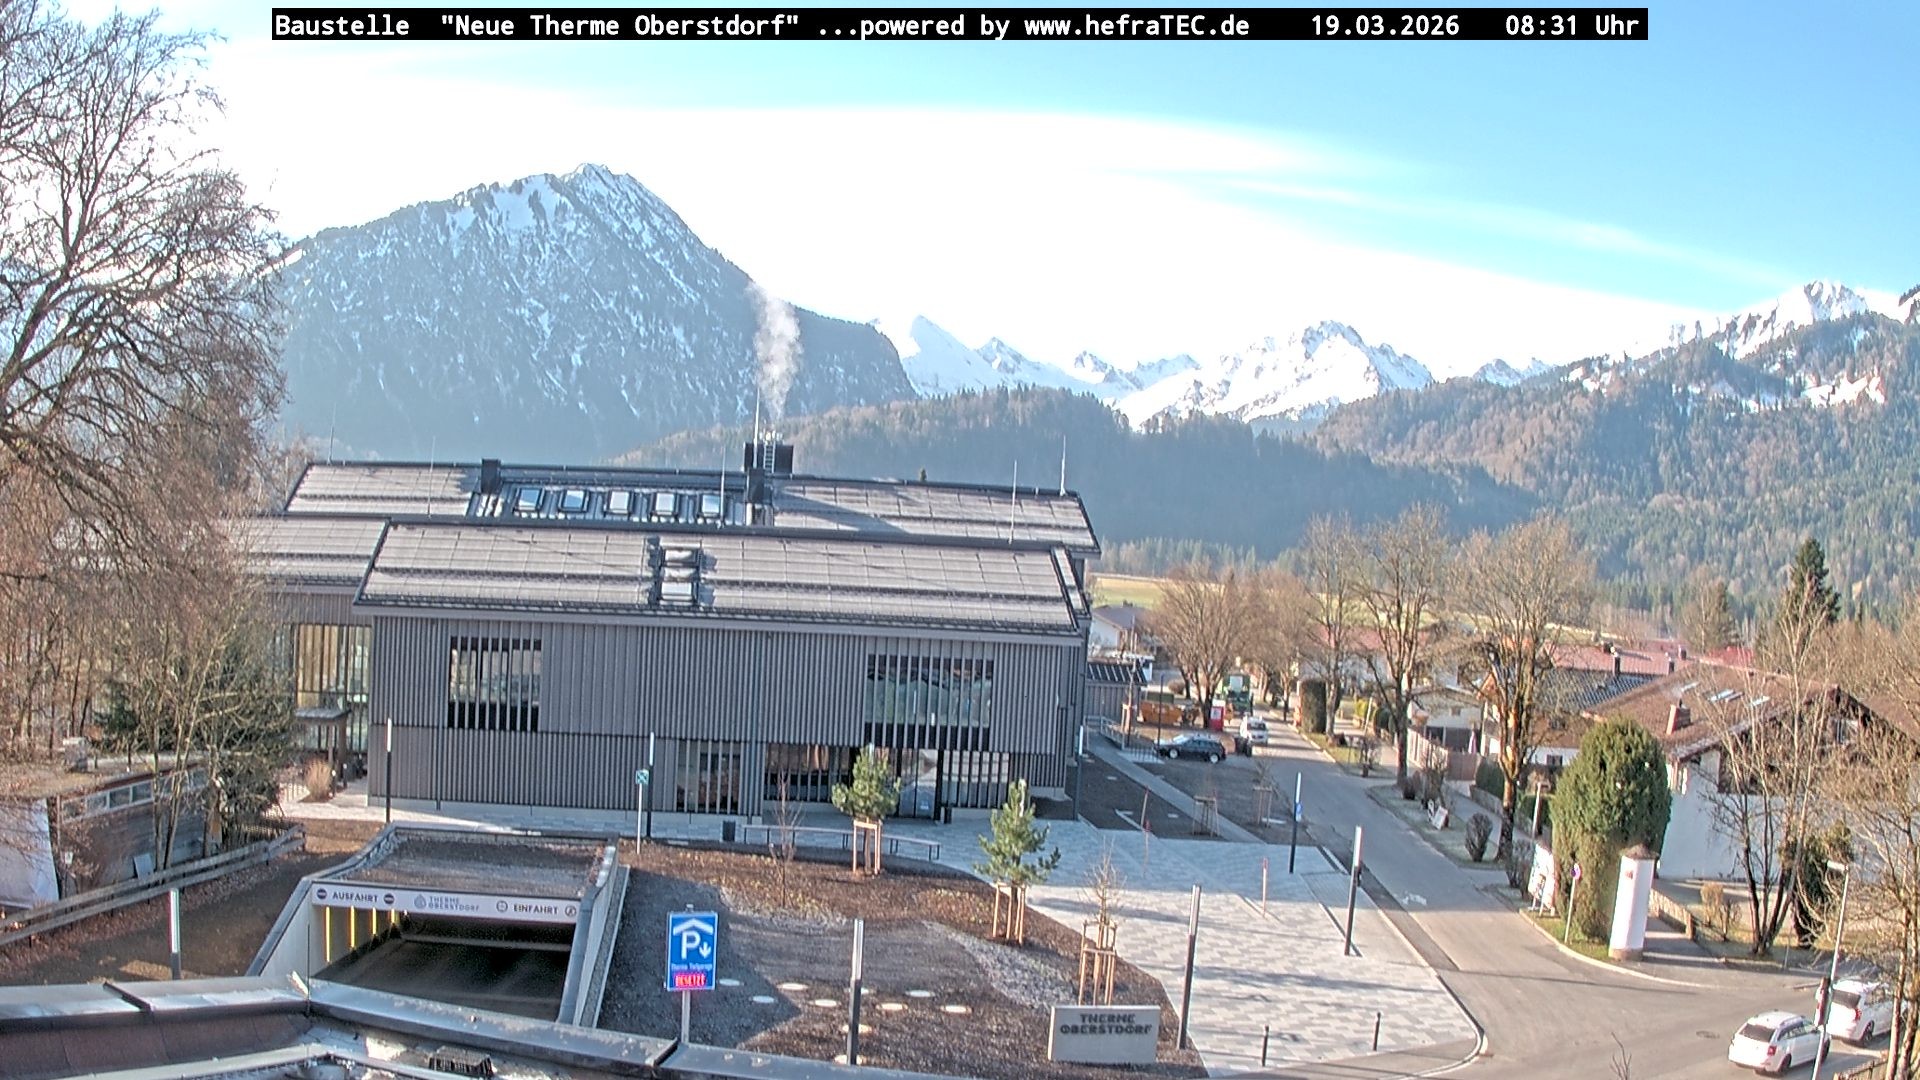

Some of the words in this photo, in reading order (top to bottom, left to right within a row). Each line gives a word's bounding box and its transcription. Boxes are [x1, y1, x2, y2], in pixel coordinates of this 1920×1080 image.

[332, 891, 378, 903] AUSFAHRT
[513, 904, 559, 915] EINFAHRT
[682, 930, 701, 960] P
[1080, 1013, 1136, 1023] THERME
[1060, 1024, 1152, 1034] OBERSTDORF
